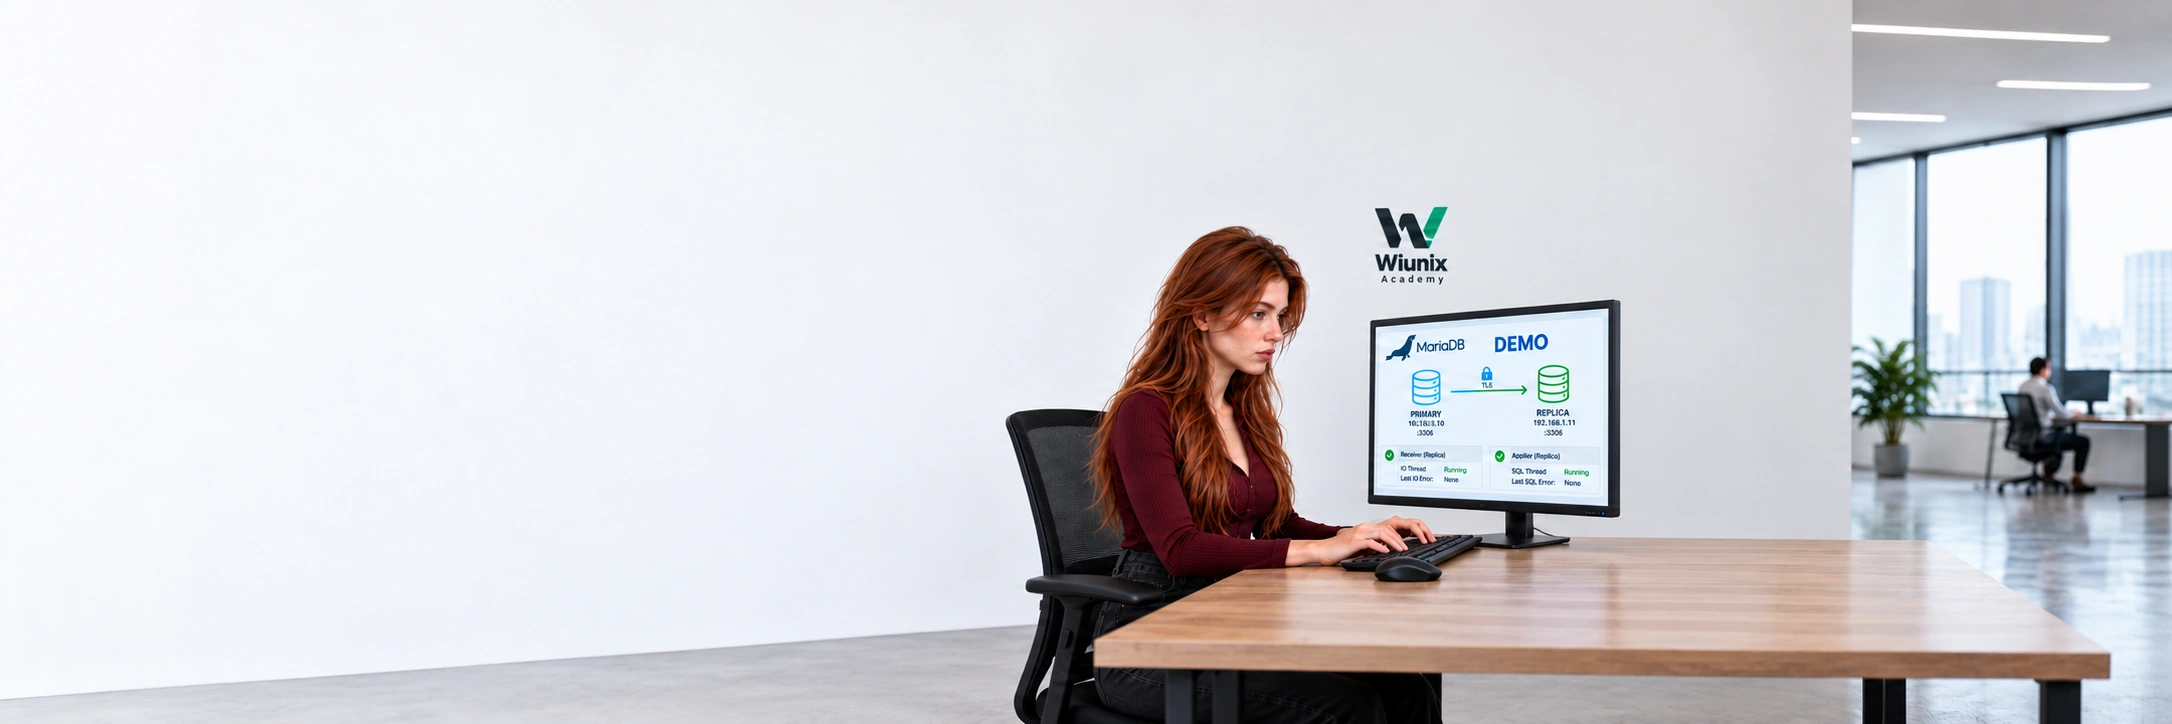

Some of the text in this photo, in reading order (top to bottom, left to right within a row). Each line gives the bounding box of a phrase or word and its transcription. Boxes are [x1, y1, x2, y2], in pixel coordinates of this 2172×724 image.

[1375, 254, 1448, 272] Wiunix
[1381, 275, 1444, 285] Academy
[1416, 339, 1465, 352] MariaDB
[1494, 334, 1549, 352] DEMO
[1536, 409, 1570, 417] REPLICA
[1443, 466, 1467, 474] Running
[1564, 469, 1590, 477] Running
[1525, 478, 1537, 486] SQL
